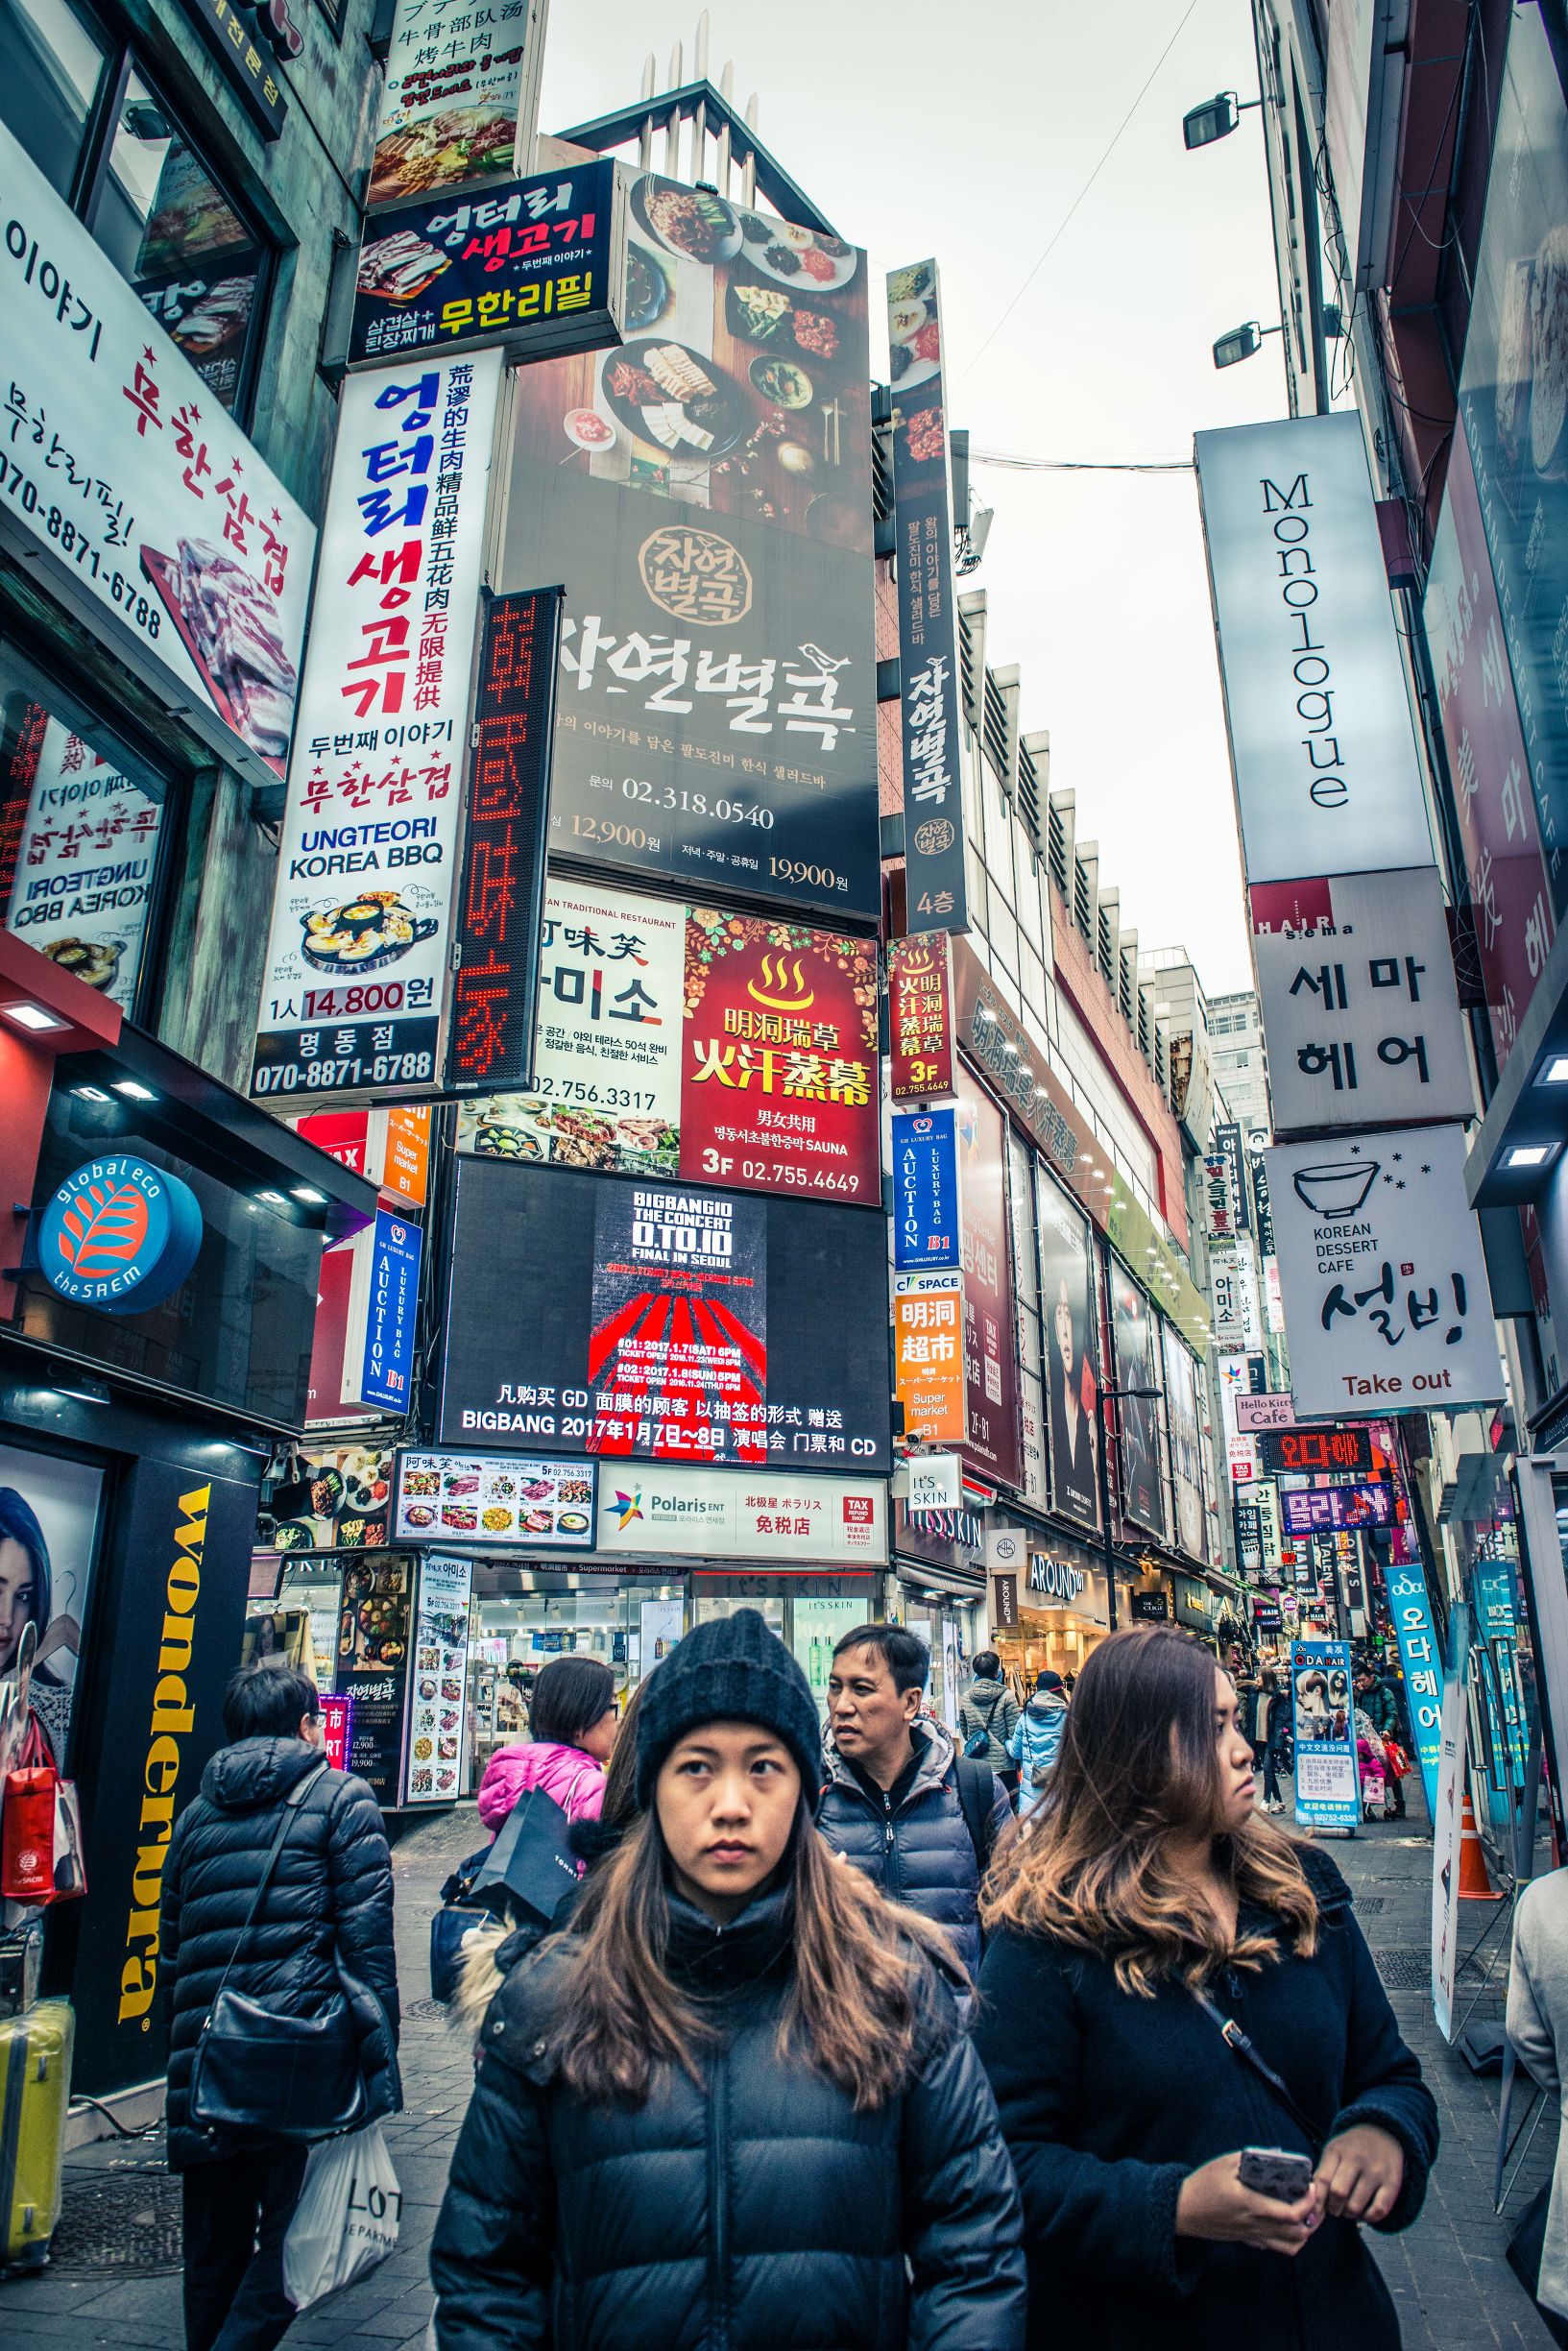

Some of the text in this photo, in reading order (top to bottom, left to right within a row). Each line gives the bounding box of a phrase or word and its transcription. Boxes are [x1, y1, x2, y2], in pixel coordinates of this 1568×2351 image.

[398, 1, 523, 47] 牛骨部队汤
[413, 33, 493, 69] 烤牛肉
[425, 182, 573, 248] 엉터리
[461, 213, 595, 273] 생고기
[521, 249, 585, 271] 두번째 이야기
[4, 218, 102, 363] 이야기
[439, 272, 592, 334] 무한리필
[365, 323, 436, 353] 된장찌개
[122, 358, 292, 597] 무한삼겹
[340, 371, 441, 718] 엉터리 생고기
[909, 570, 922, 594] 한식
[926, 542, 942, 618] 이야기를 담은
[1260, 473, 1349, 809] Monologue
[308, 719, 453, 759] 두번째 이야기
[908, 664, 952, 805] 자연별곡
[584, 719, 826, 789] 이야기를 담은 팔도진미 한식 샐러드바
[299, 763, 452, 814] 무한삼겹
[589, 774, 774, 831] 문의 02.318.0540
[302, 816, 437, 853] UNGTEORI
[289, 842, 444, 881] KOREA BBQ
[563, 900, 676, 930] TRADITIONAL RESTAURANT
[917, 891, 954, 915] 4층
[1258, 916, 1331, 935] HAIR
[1289, 956, 1426, 1011] 세마
[899, 977, 921, 1056] 火汗蒸幕
[920, 973, 944, 1054] 明洞瑞草
[545, 1026, 668, 1055] 공간 야외 테라스 50석 완비
[723, 1007, 841, 1053] 明洞瑞草
[544, 1037, 659, 1066] 정갈한 친절한 서비스
[1297, 1035, 1430, 1090] 헤어
[255, 1053, 431, 1093] 070-8871-6788
[689, 1038, 873, 1108] 火汗蒸幕
[910, 1060, 938, 1083] 3F
[533, 1075, 656, 1112] 02.756.3317
[895, 1080, 949, 1096] 02.755.4649
[757, 1108, 816, 1134] 男女共用
[396, 1140, 418, 1161] Super
[713, 1125, 848, 1157] 명동서초불한증막 SAUNA
[394, 1154, 418, 1176] market
[702, 1148, 860, 1194] 3F 02.755.4649
[931, 1148, 941, 1197] LUXURY
[57, 1159, 161, 1204] global eco
[399, 1176, 411, 1192] B1
[903, 1148, 919, 1248] AUCTION
[634, 1207, 733, 1231] THE CONCERT
[1314, 1223, 1371, 1241] KOREAN
[928, 1235, 950, 1250] B1
[1316, 1239, 1379, 1257] DESSERT
[632, 1247, 732, 1269] FINAL IN SEOUL
[1318, 1259, 1354, 1274] CAFE
[919, 1277, 958, 1290] SPACE
[394, 1266, 408, 1359] LUXURY BAG
[902, 1299, 954, 1329] 明洞
[1215, 1276, 1235, 1323] 아미소
[1320, 1261, 1468, 1346] 설빙
[370, 1255, 392, 1380] AUCTION
[617, 1349, 646, 1359] TICKET
[647, 1351, 667, 1361] OPEN
[718, 1346, 740, 1359] 6PM
[901, 1333, 954, 1364] 超市
[386, 1369, 405, 1392] B1
[616, 1374, 645, 1384] TICKET
[646, 1376, 666, 1385] OPEN
[717, 1371, 740, 1383] 5PM
[899, 1374, 961, 1386] スーパーマーケット
[1342, 1369, 1452, 1396] Take out
[496, 1384, 843, 1429] 凡购买 GD 面膜的顾客 以抽签的形式 赠送
[911, 1404, 948, 1417] market
[913, 1393, 945, 1406] Super
[1241, 1397, 1291, 1410] Hello Kitty
[462, 1410, 555, 1435] BIGBANG
[732, 1426, 785, 1451] 演唱会
[793, 1430, 845, 1453] 门票和
[851, 1438, 876, 1456] CD
[923, 1423, 938, 1436] B1
[542, 1466, 552, 1476] 5F
[553, 1468, 591, 1478] 02.756.3317
[651, 1495, 725, 1513] Polaris ENT
[745, 1496, 822, 1511] 北极星 ポラリス
[848, 1500, 869, 1511] TAX
[913, 1491, 947, 1505] SKIN
[756, 1515, 810, 1536] 免税店
[443, 1563, 466, 1578] 아미소
[578, 1563, 627, 1573] Supermarket
[1292, 1540, 1309, 1582] HAIR
[776, 1576, 842, 1597] SKIN
[829, 1601, 853, 1610] SKIN
[1294, 1655, 1345, 1666] ODA HAIR
[1402, 1607, 1440, 1732] 오다헤어
[118, 1483, 211, 2024] wonderbra
